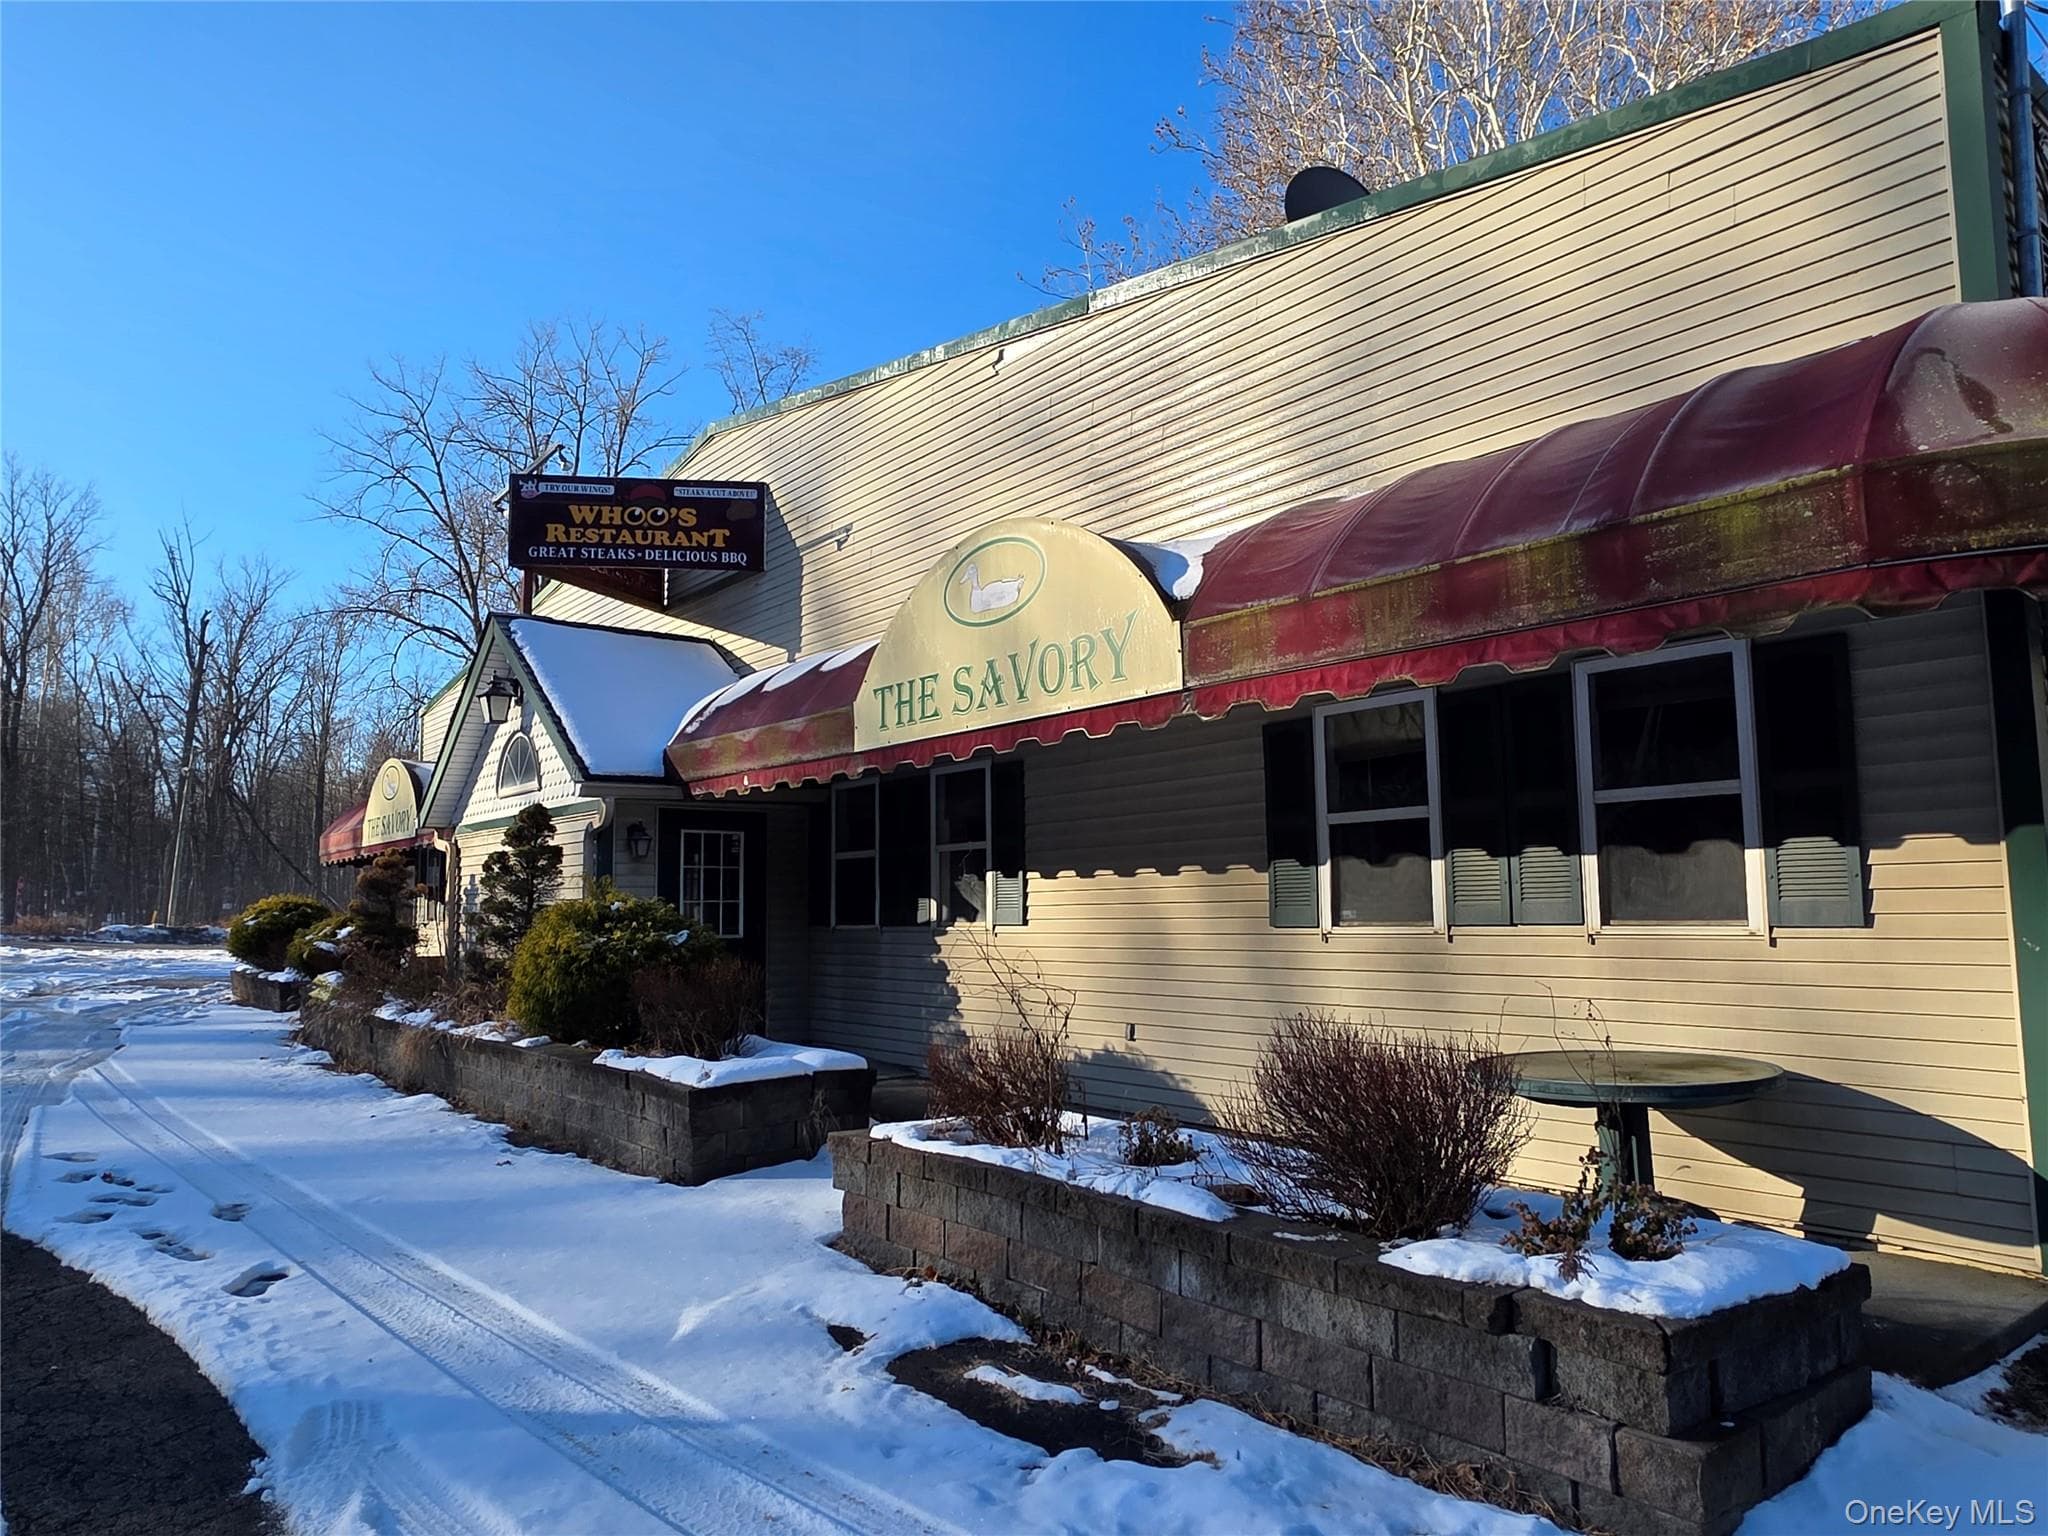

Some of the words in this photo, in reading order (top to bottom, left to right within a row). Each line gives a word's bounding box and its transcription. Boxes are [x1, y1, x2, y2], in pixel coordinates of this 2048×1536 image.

[561, 484, 579, 493] OUR
[712, 489, 726, 497] CUT
[568, 504, 697, 526] WHOO'S
[545, 523, 730, 547] RESTAURANT
[528, 546, 575, 559] GREAT
[580, 548, 635, 561] STEAKS
[645, 549, 718, 563] DELICIOUS
[721, 552, 748, 566] BBQ
[873, 672, 942, 732] THE
[951, 609, 1141, 716] SAVORY
[368, 816, 381, 838] THE
[381, 804, 413, 836] SAVORY
